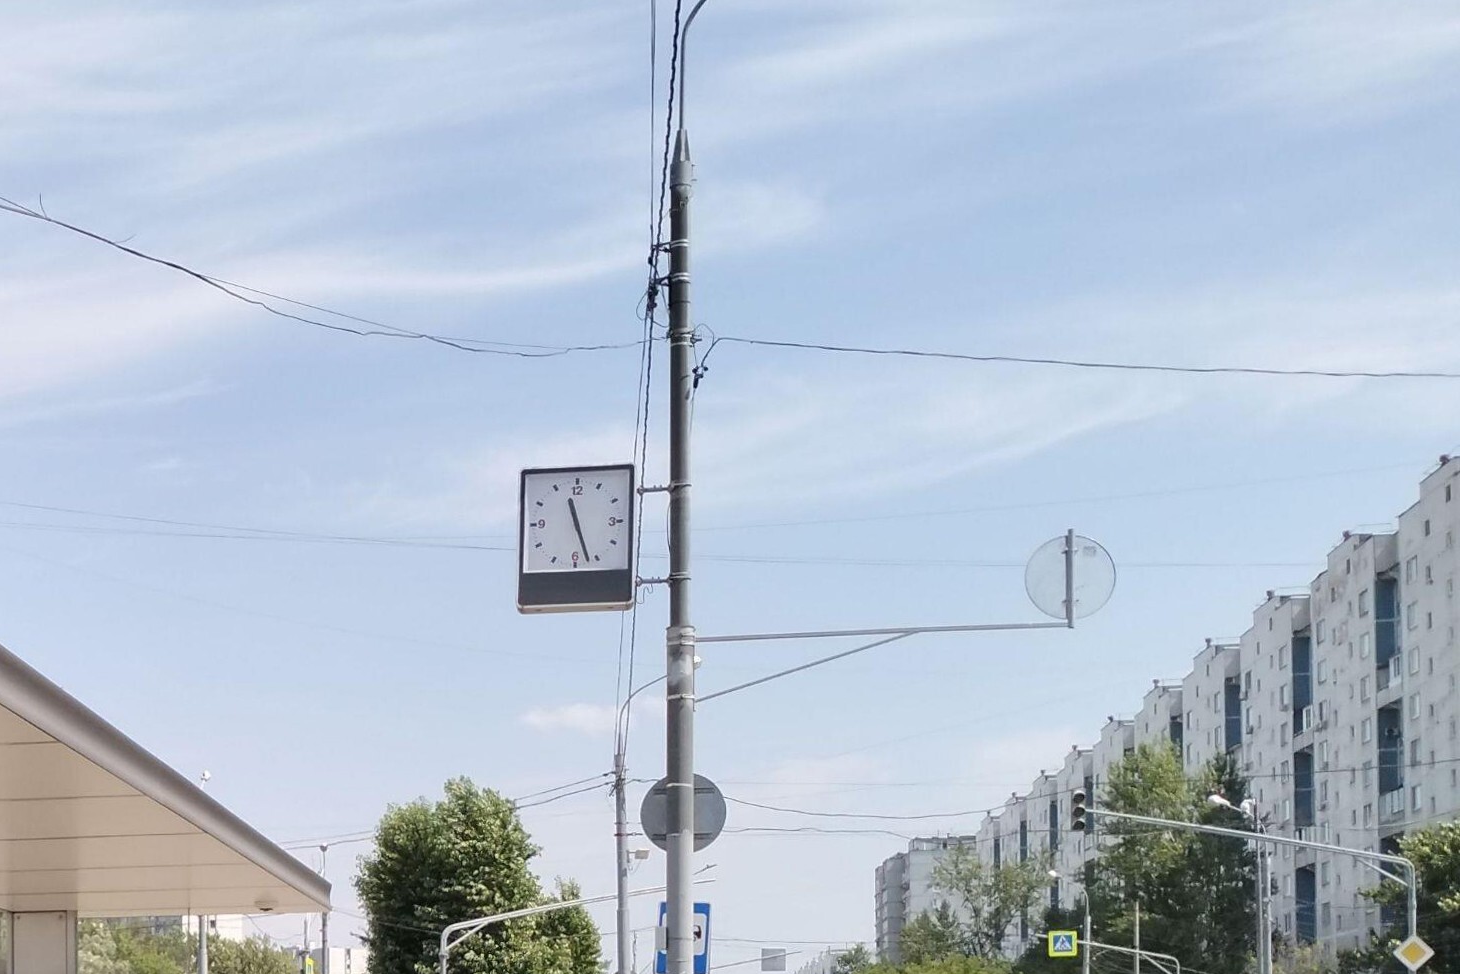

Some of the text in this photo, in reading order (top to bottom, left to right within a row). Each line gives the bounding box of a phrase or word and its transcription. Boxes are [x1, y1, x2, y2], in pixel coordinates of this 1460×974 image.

[571, 486, 583, 496] 12
[538, 519, 546, 529] 9
[608, 516, 616, 527] 3
[571, 551, 579, 561] 6
